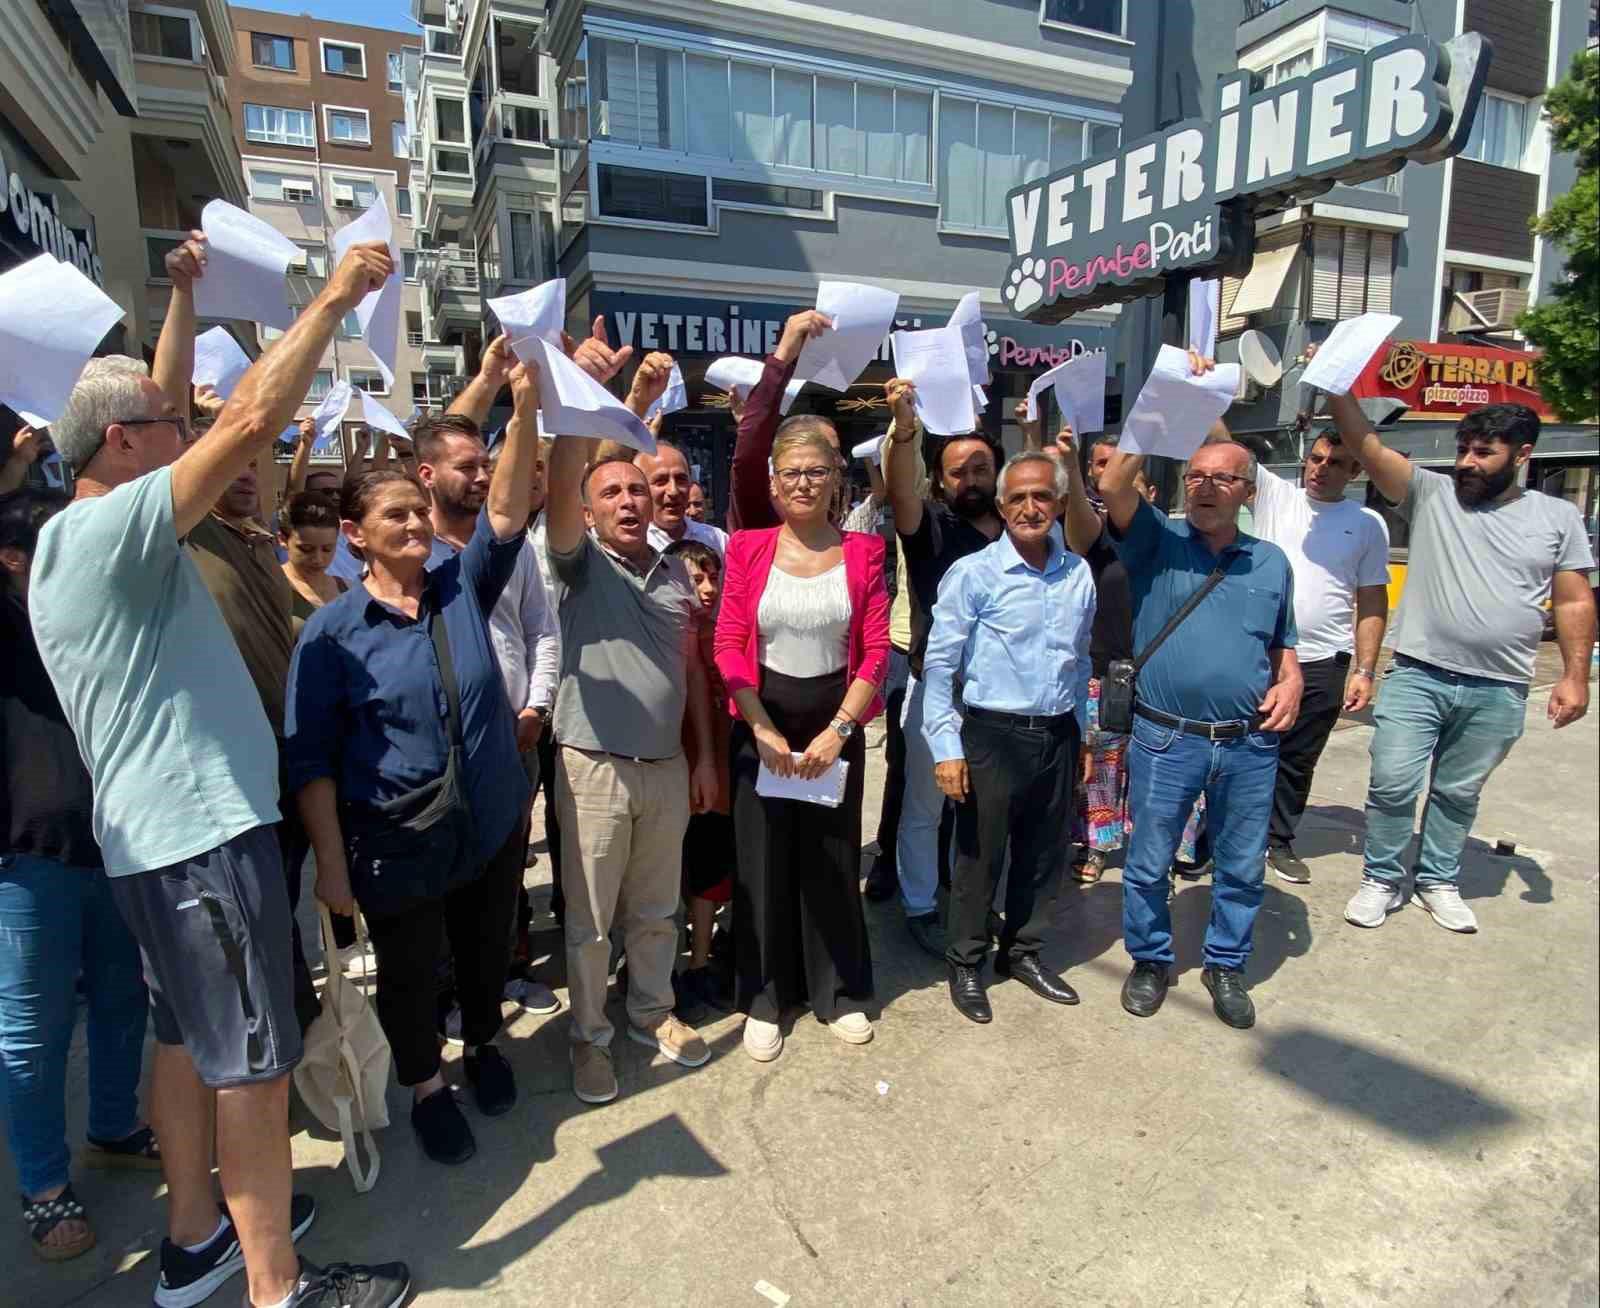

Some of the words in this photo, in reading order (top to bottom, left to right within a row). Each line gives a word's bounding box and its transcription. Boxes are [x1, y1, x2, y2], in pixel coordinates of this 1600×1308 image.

[1011, 48, 1427, 257] VETERİNER
[615, 305, 781, 354] VETERİNE
[1428, 354, 1506, 385] TERRA
